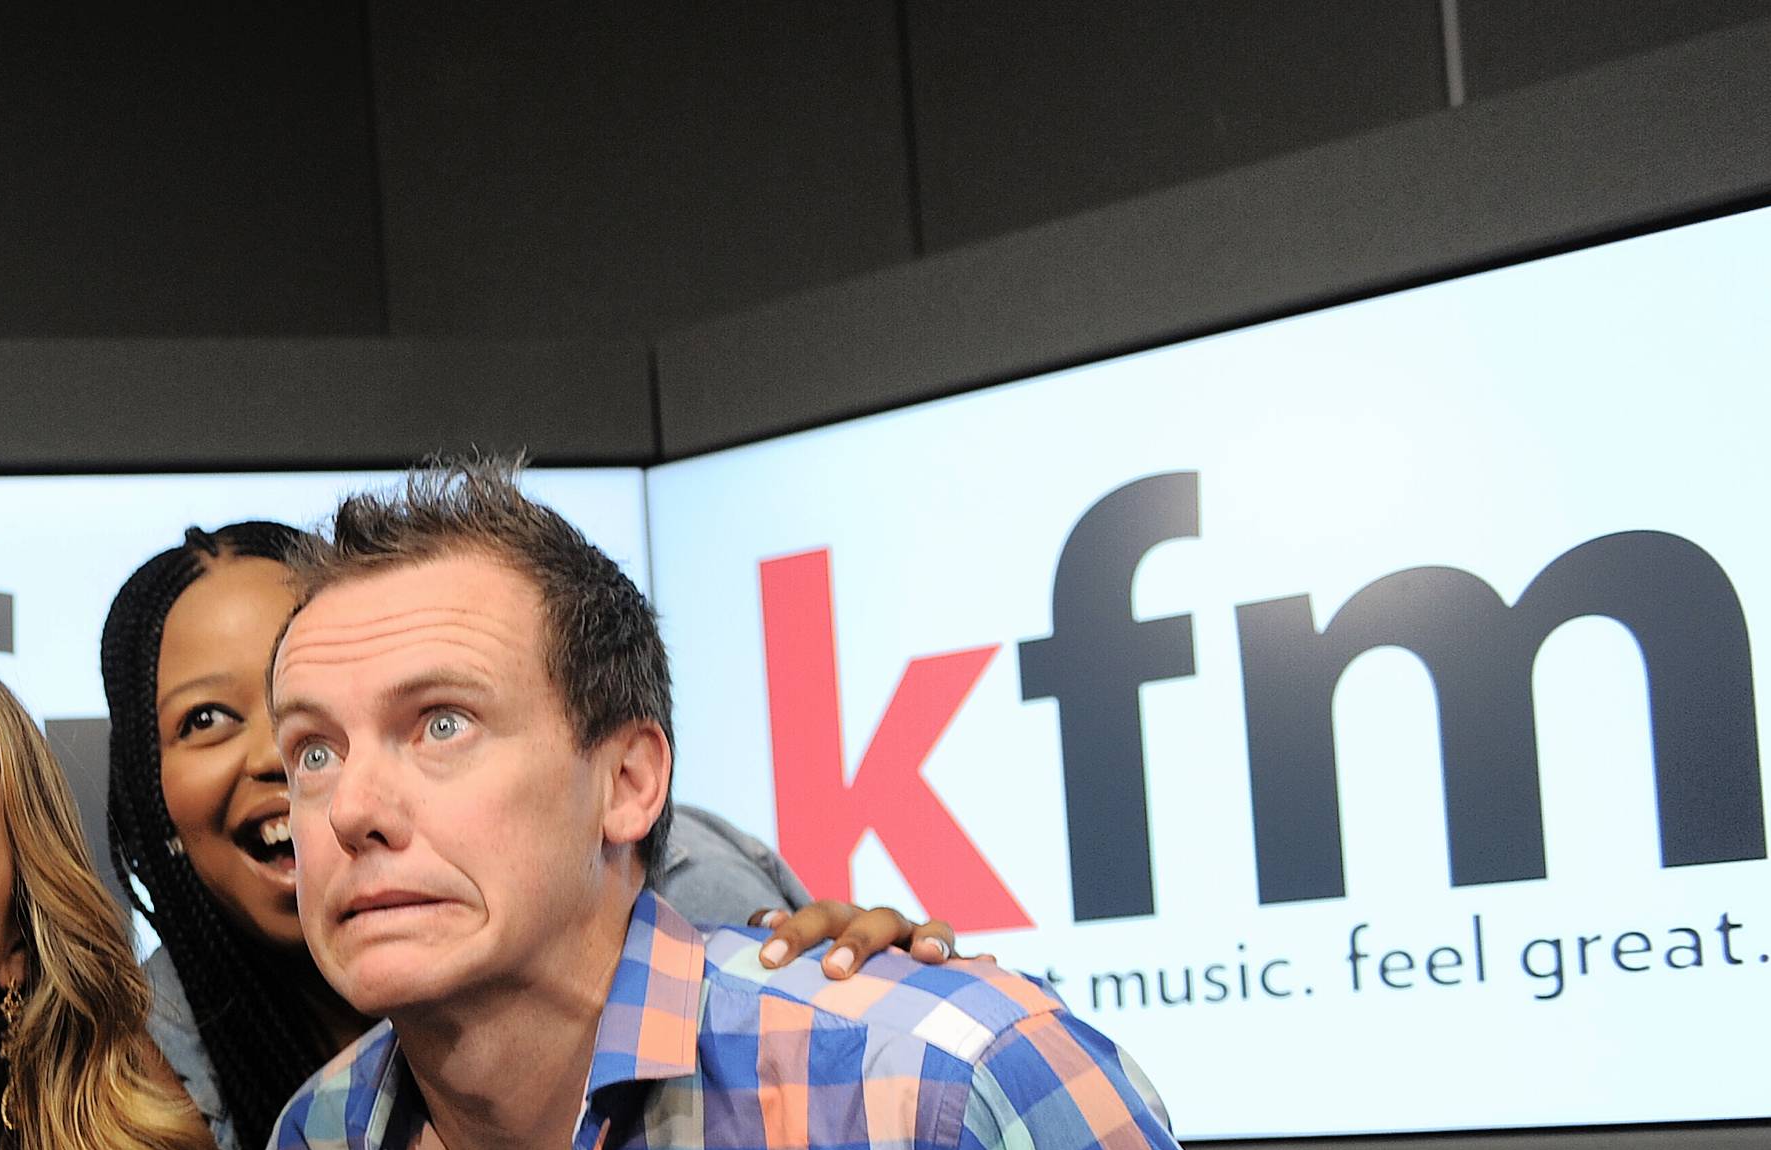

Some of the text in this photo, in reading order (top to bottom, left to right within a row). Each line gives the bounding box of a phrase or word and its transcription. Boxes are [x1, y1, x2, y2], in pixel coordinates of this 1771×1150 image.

[758, 470, 1769, 936] kfm
[1091, 911, 1770, 1010] music. feel great.
